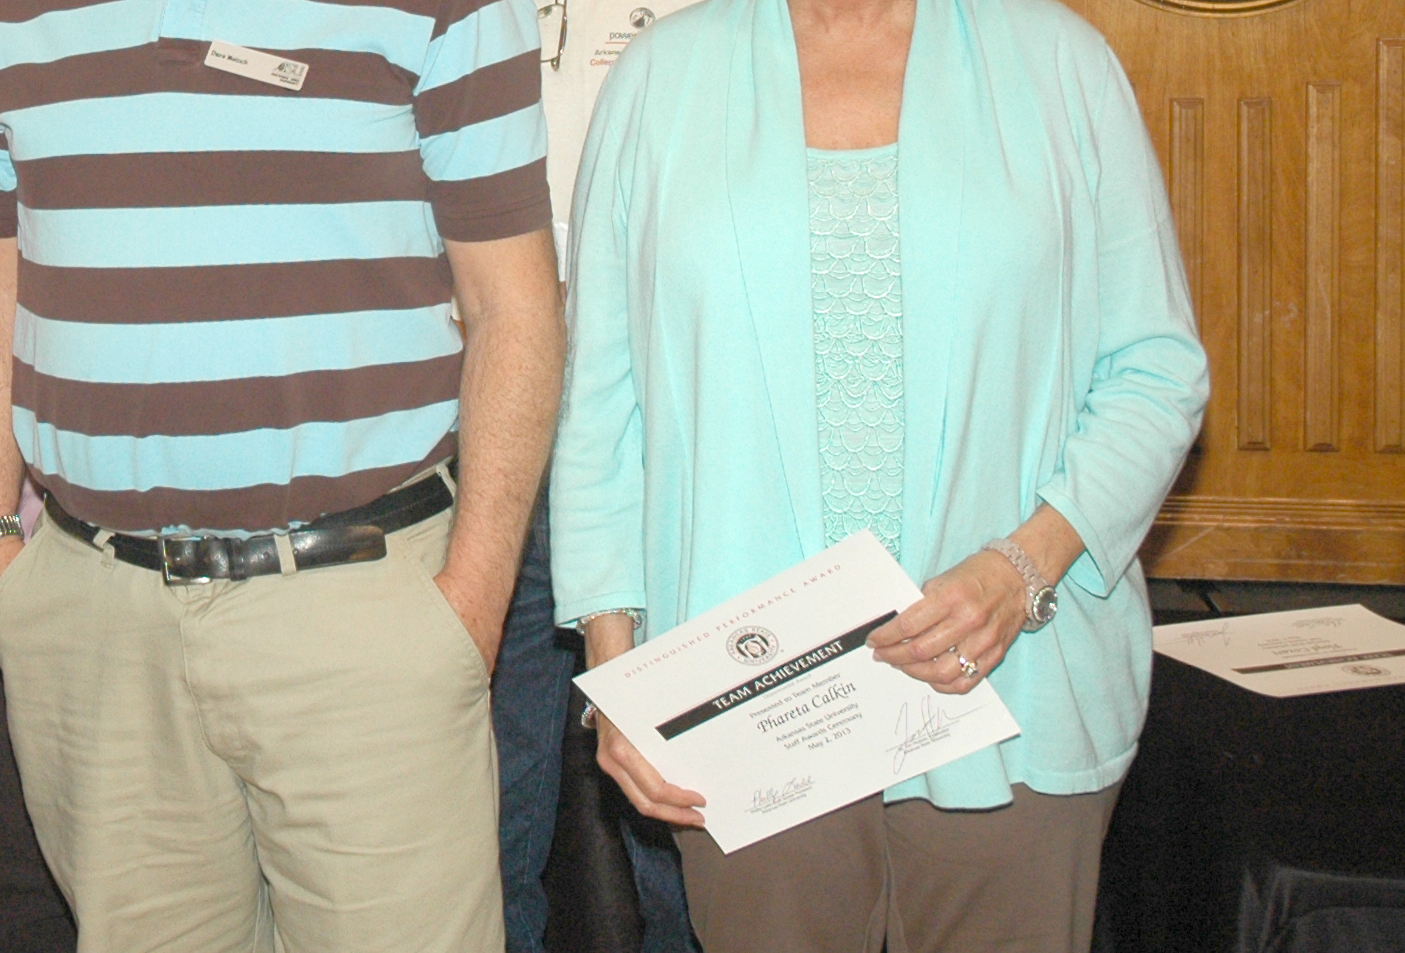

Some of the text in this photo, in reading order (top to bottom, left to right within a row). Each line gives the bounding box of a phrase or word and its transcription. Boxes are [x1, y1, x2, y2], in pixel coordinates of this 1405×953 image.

[623, 564, 842, 679] DISTINGUISHED PERFORMANCE AWARD
[712, 639, 845, 710] TEAM ACHIEVEMENT
[749, 699, 783, 719] Presented
[793, 687, 812, 699] Team
[811, 672, 841, 690] Member
[756, 680, 857, 734] Phareta Calkin
[775, 702, 860, 743] Arkansas State University
[807, 739, 824, 751] May
